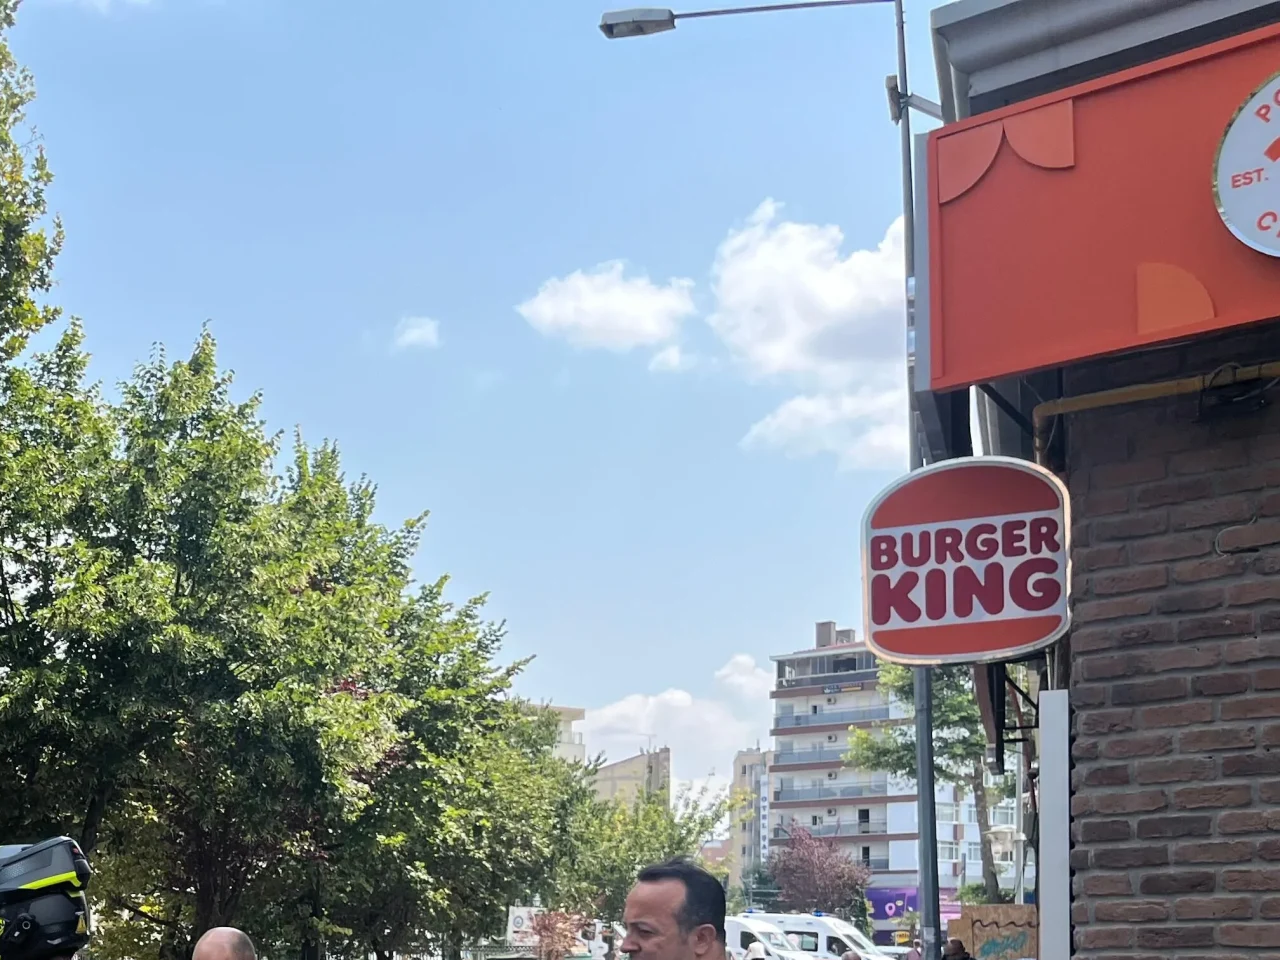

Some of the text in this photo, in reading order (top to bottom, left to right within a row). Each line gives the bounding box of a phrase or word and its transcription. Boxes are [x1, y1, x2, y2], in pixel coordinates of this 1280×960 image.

[1231, 168, 1269, 188] EST.
[870, 517, 1061, 571] BURGER
[871, 557, 1062, 626] KING
